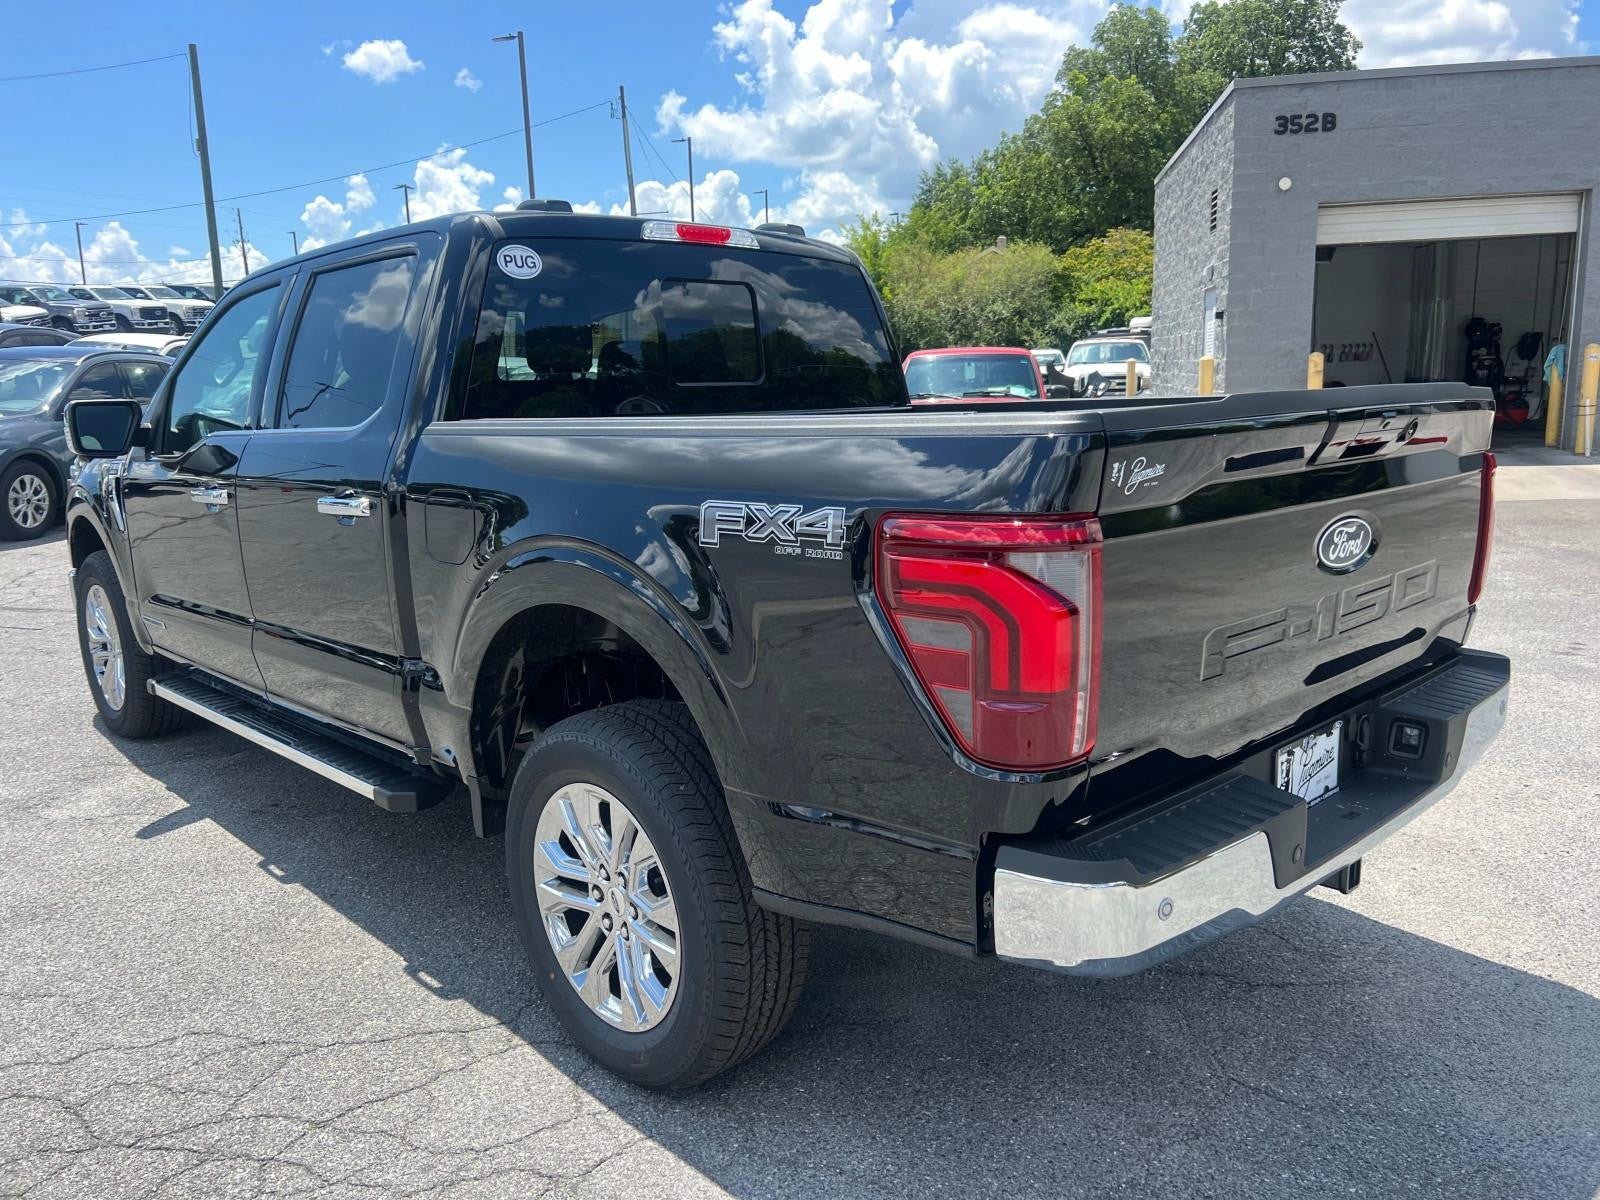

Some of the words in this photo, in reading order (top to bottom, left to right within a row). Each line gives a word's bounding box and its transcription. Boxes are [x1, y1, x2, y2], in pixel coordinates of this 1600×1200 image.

[1274, 112, 1337, 136] 352B
[503, 254, 536, 270] PUG
[698, 500, 847, 550] FX4
[774, 546, 802, 556] OFF
[805, 548, 844, 560] ROAD
[1329, 525, 1364, 560] Ford
[1199, 559, 1440, 682] F-150
